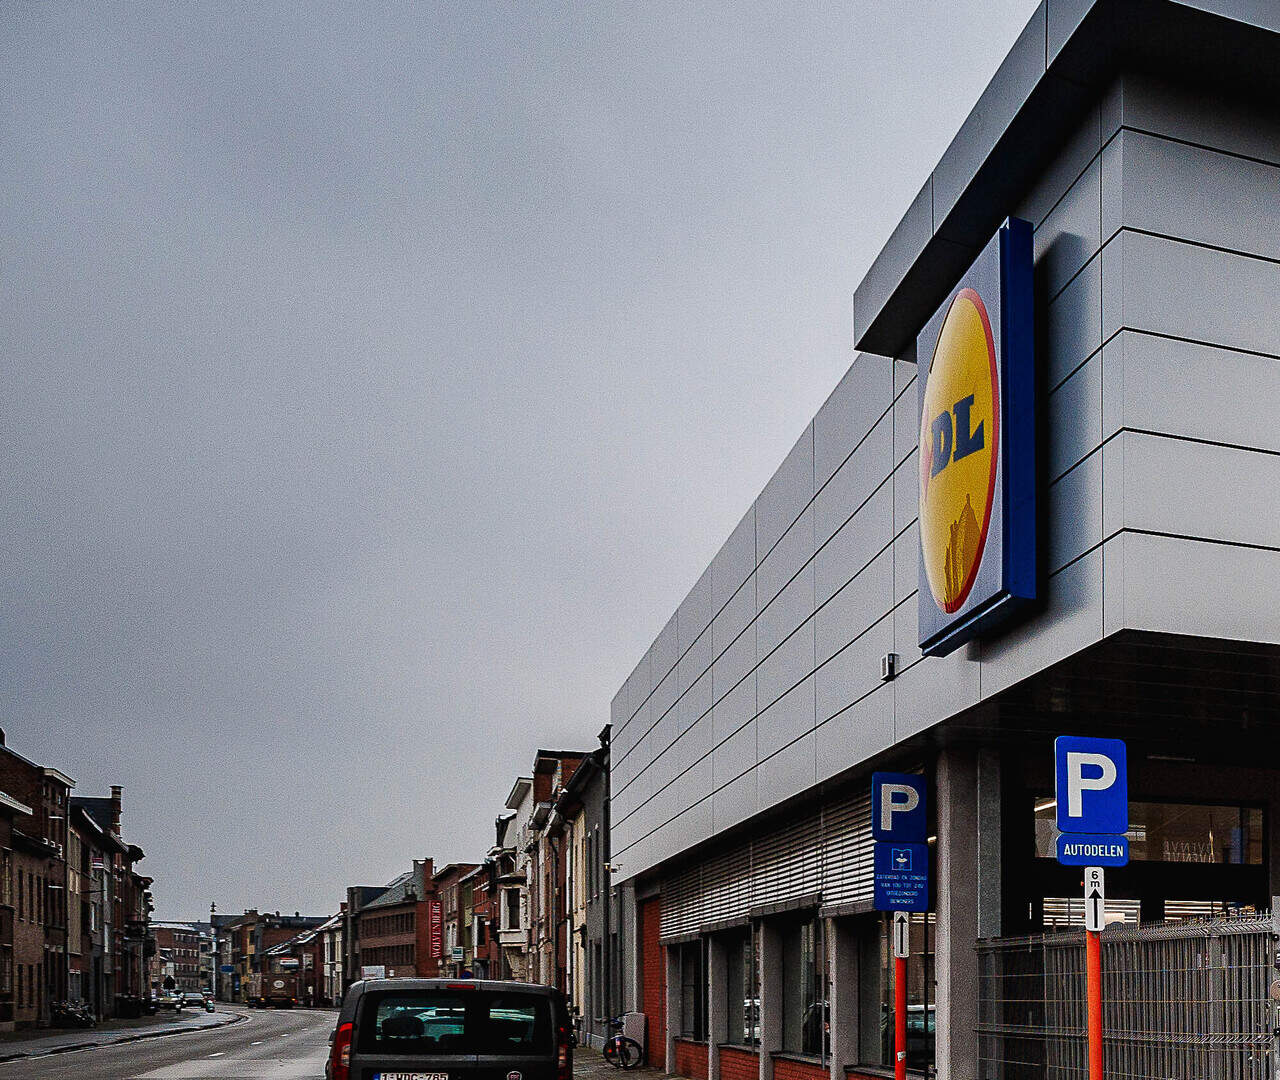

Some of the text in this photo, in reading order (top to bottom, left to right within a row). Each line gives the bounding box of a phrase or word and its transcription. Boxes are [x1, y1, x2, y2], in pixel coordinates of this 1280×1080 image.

[1067, 752, 1117, 817] P
[881, 784, 919, 830] P
[1063, 843, 1124, 857] AUTODELEN
[1091, 870, 1099, 880] 6
[1090, 880, 1100, 888] m
